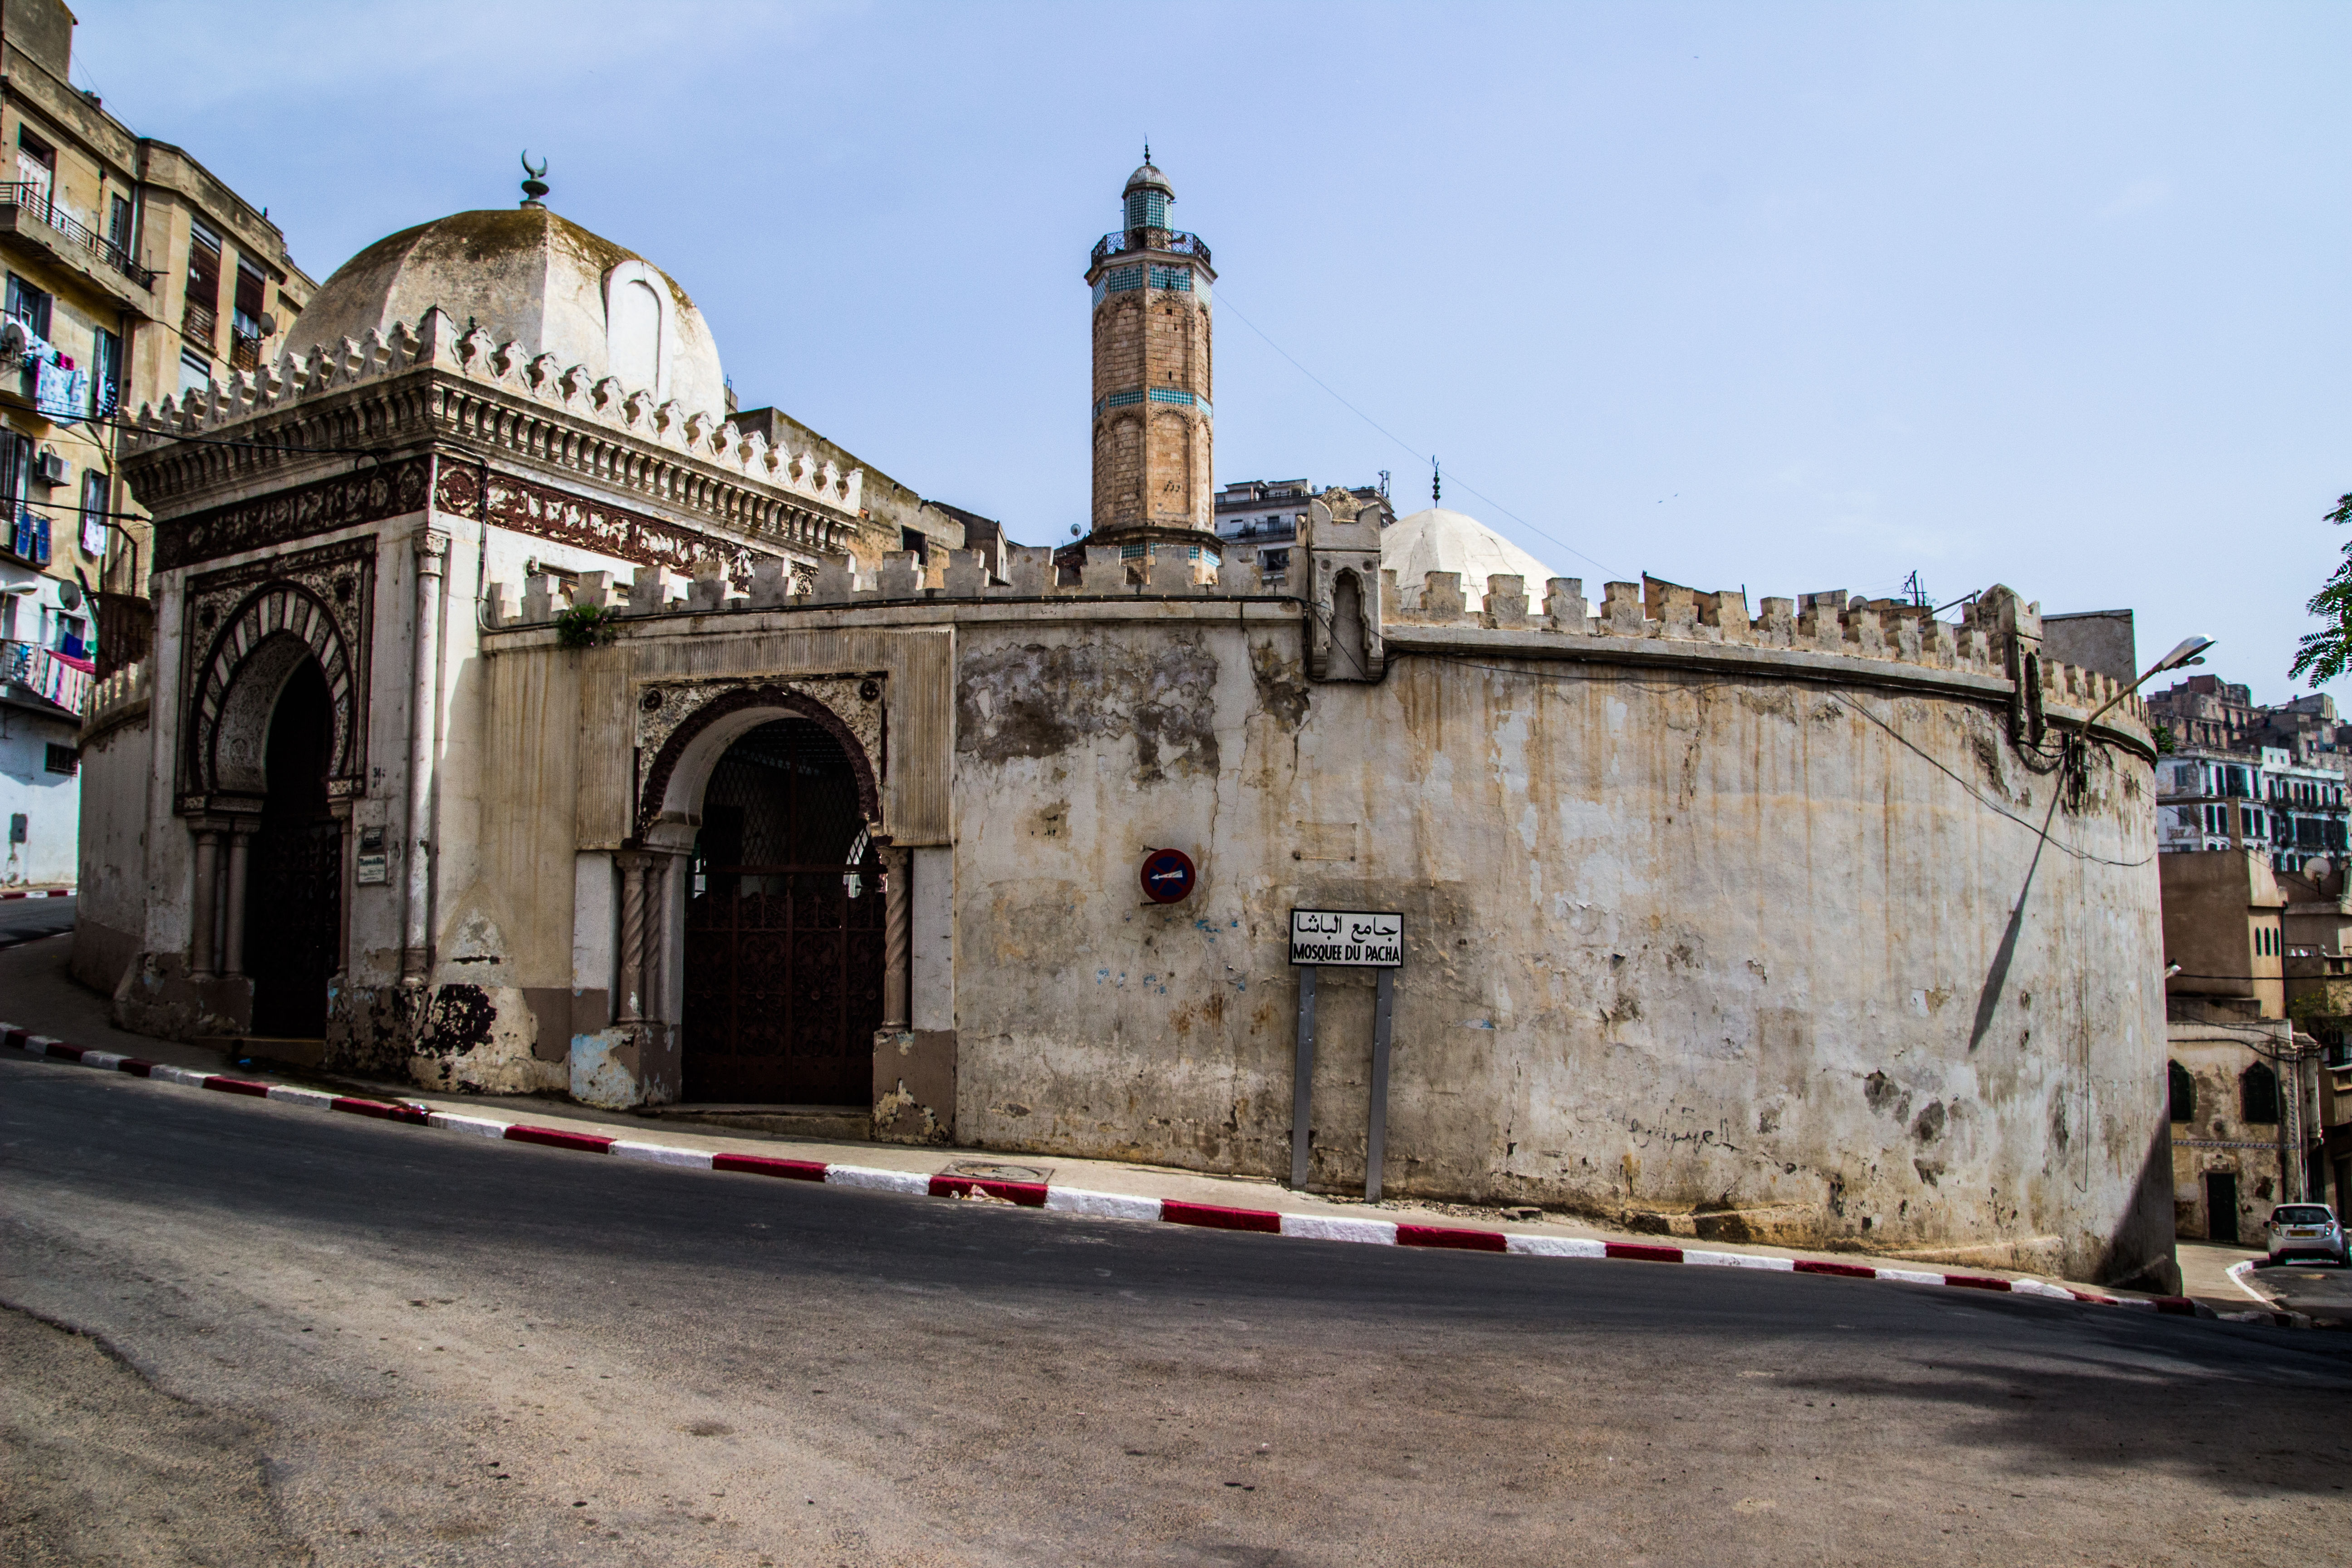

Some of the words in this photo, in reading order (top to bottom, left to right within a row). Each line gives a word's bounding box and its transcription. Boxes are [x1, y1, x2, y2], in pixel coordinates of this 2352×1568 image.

[1297, 913, 1342, 940] الباشا
[1351, 916, 1398, 943] جامع
[1293, 943, 1342, 961] MOSQUEE
[1345, 945, 1360, 960] DU
[1365, 945, 1400, 962] PACHA
